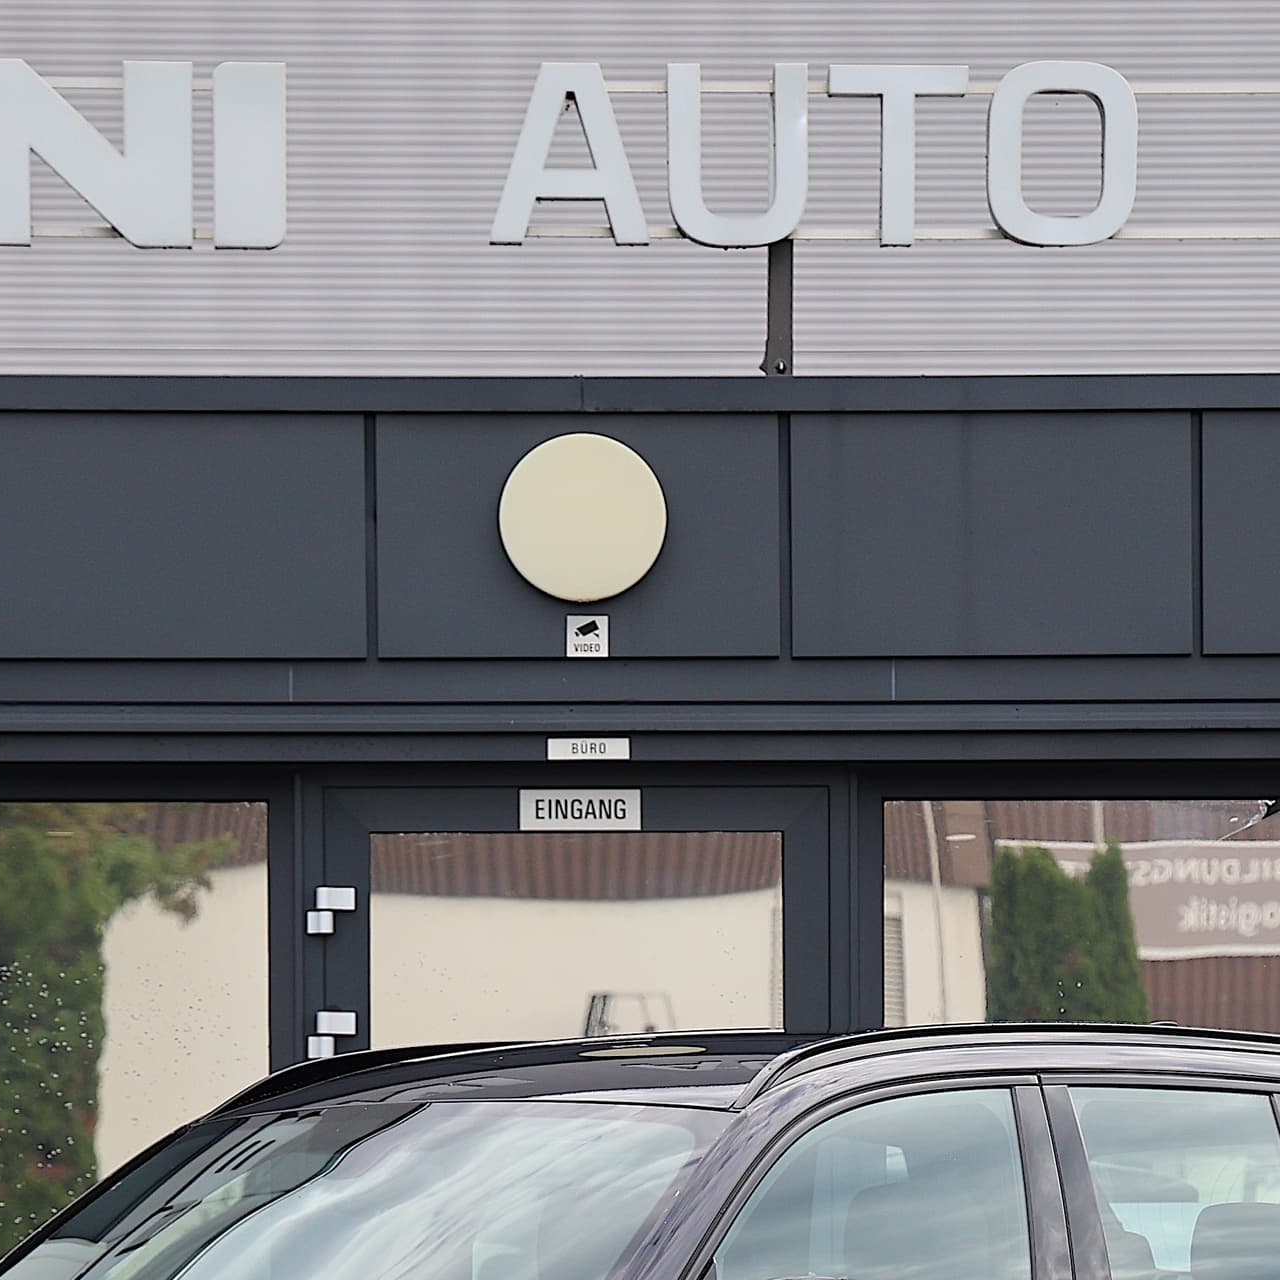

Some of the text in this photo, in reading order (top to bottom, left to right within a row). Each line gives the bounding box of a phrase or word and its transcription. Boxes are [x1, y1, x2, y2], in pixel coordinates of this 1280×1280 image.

[488, 58, 1140, 248] AUTO
[574, 642, 601, 653] VIDEO
[571, 740, 608, 755] BÜRO
[535, 798, 628, 821] EINGANG
